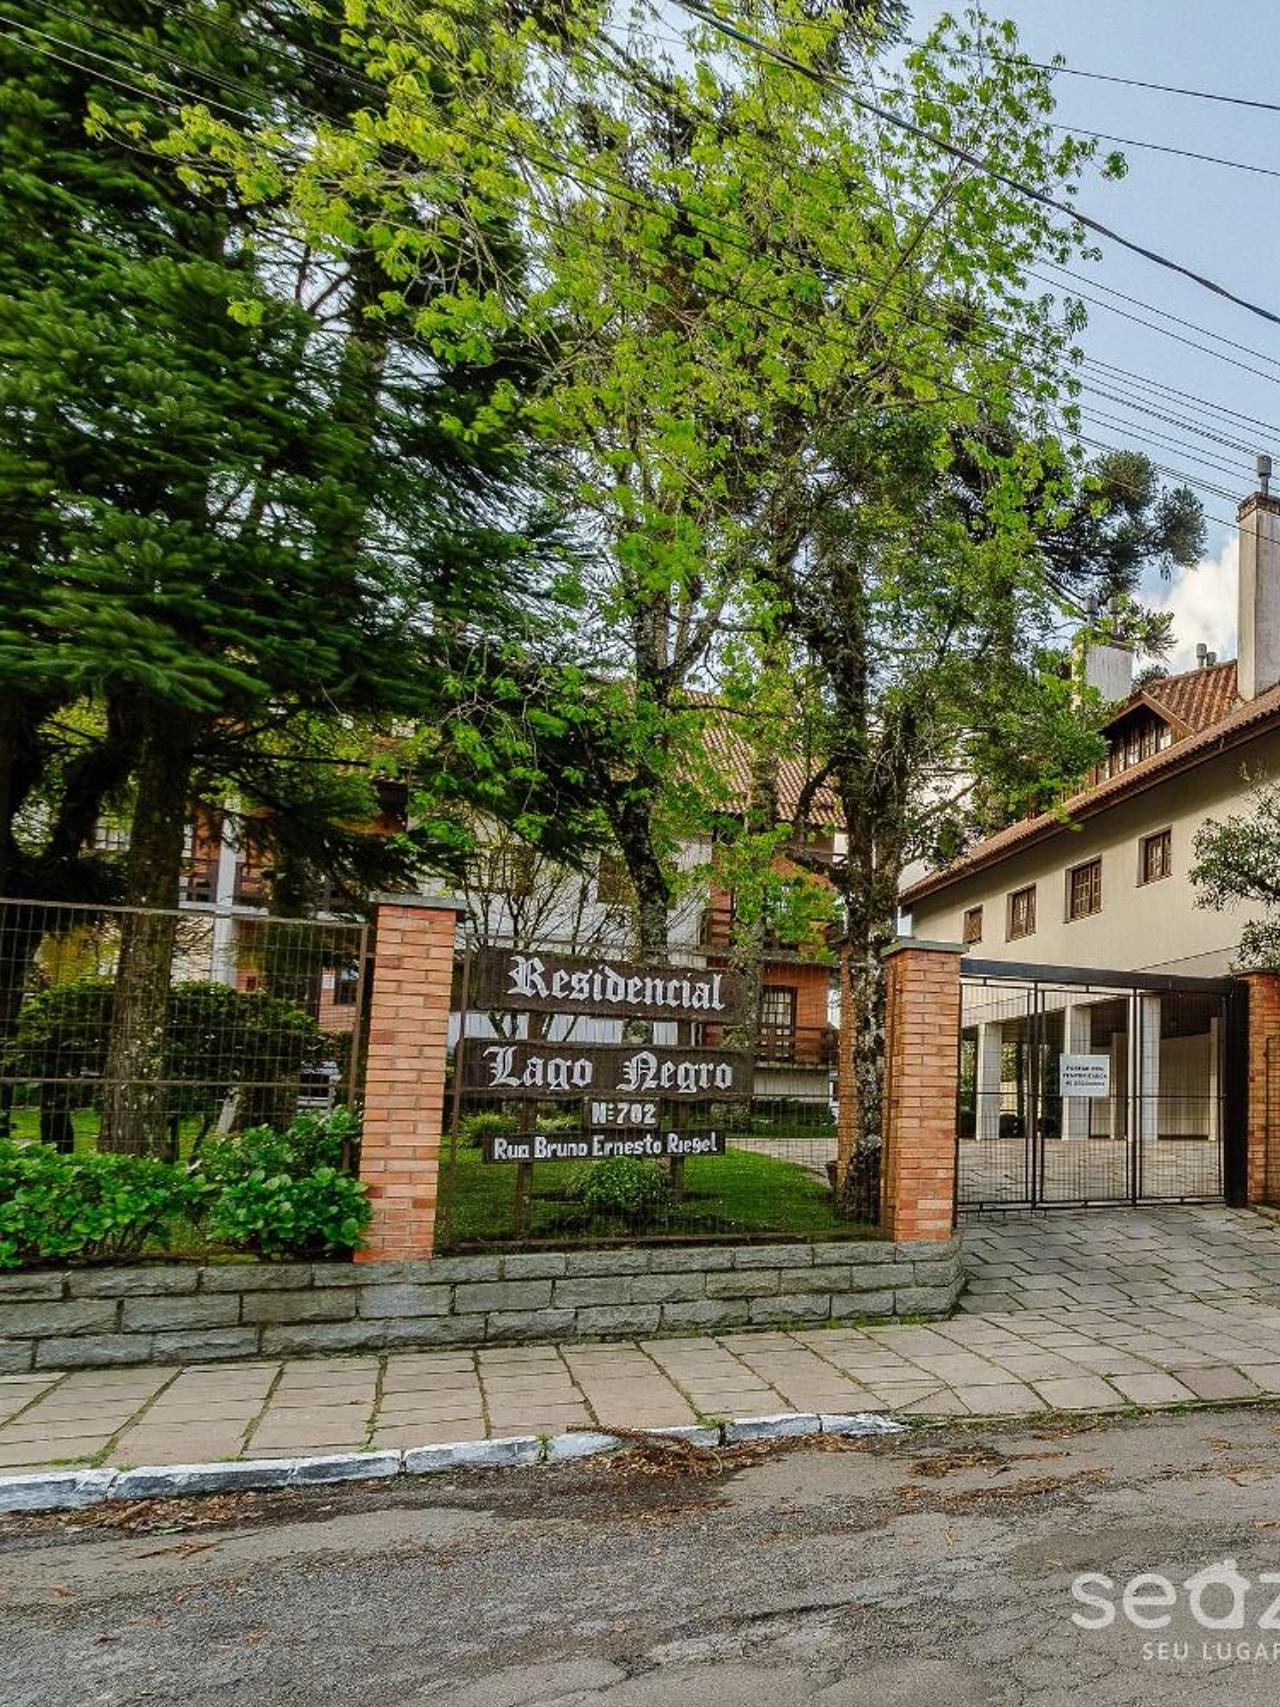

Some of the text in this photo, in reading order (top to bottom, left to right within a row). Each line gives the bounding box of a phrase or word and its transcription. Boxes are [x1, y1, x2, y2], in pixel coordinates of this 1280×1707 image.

[507, 955, 724, 1011] Residencial
[483, 1046, 733, 1093] Lago Negro
[493, 1137, 530, 1160] Rua
[533, 1136, 588, 1158] Bruno
[592, 1134, 662, 1156] Ernesto
